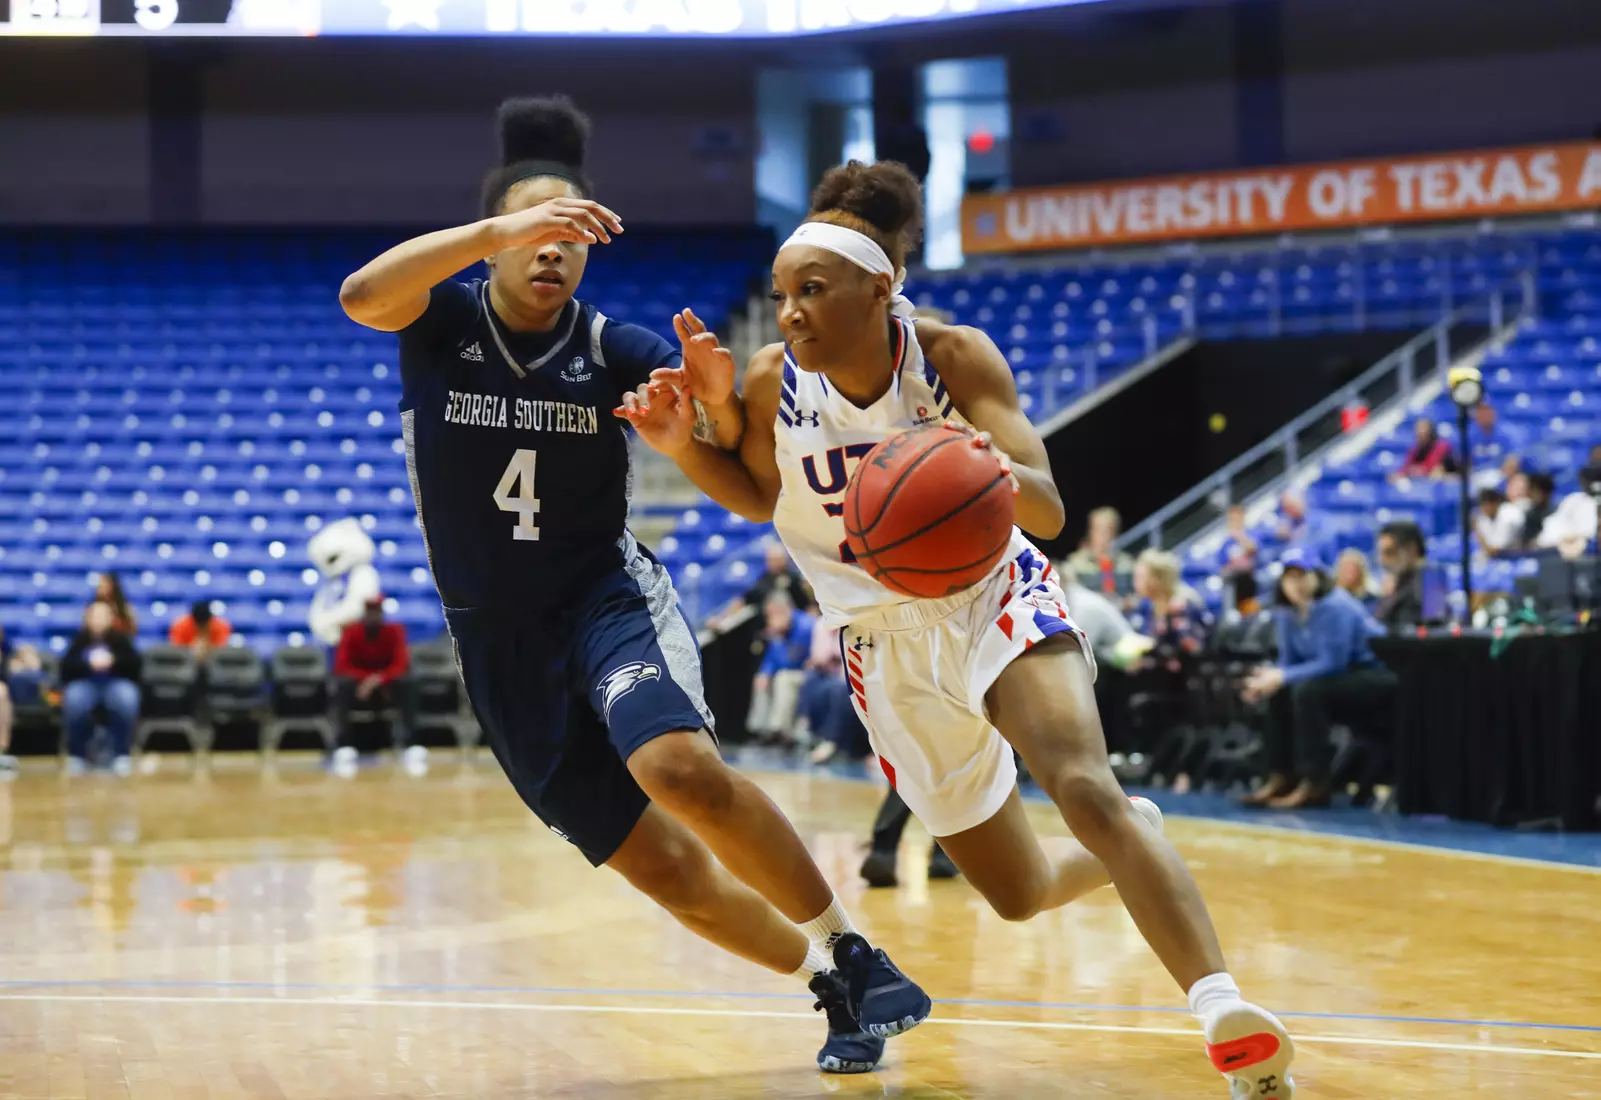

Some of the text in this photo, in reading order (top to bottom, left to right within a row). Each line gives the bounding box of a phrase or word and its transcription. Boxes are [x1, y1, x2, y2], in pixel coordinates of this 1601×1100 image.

[1005, 172, 1292, 242] UNIVERSITY
[1307, 168, 1377, 219] OF
[1388, 150, 1562, 212] TEXAS
[444, 390, 598, 435] GEORGIA SOUTHERN
[492, 448, 540, 541] 4
